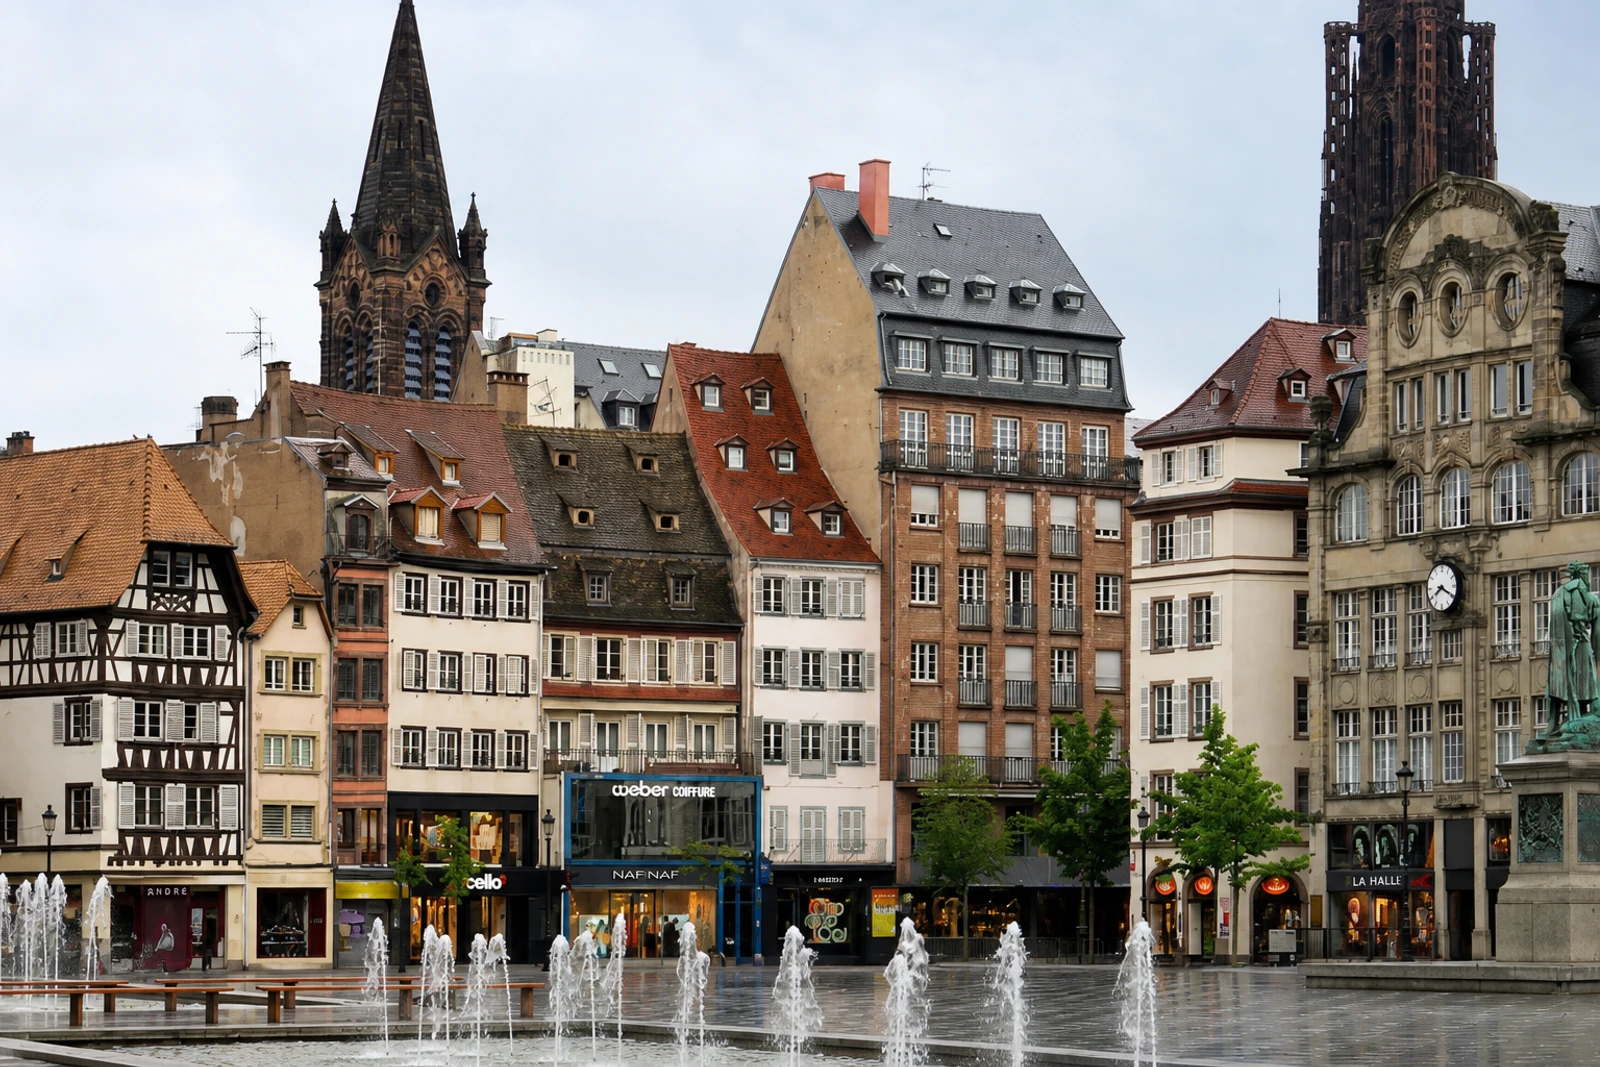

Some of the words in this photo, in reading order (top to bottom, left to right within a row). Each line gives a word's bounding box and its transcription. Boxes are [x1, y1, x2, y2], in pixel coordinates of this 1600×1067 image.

[612, 780, 669, 797] weber
[672, 786, 716, 797] COIFFURE
[612, 870, 644, 879] NAF
[647, 870, 679, 879] NAF
[1352, 876, 1366, 887] LA
[1370, 876, 1402, 886] HALLE
